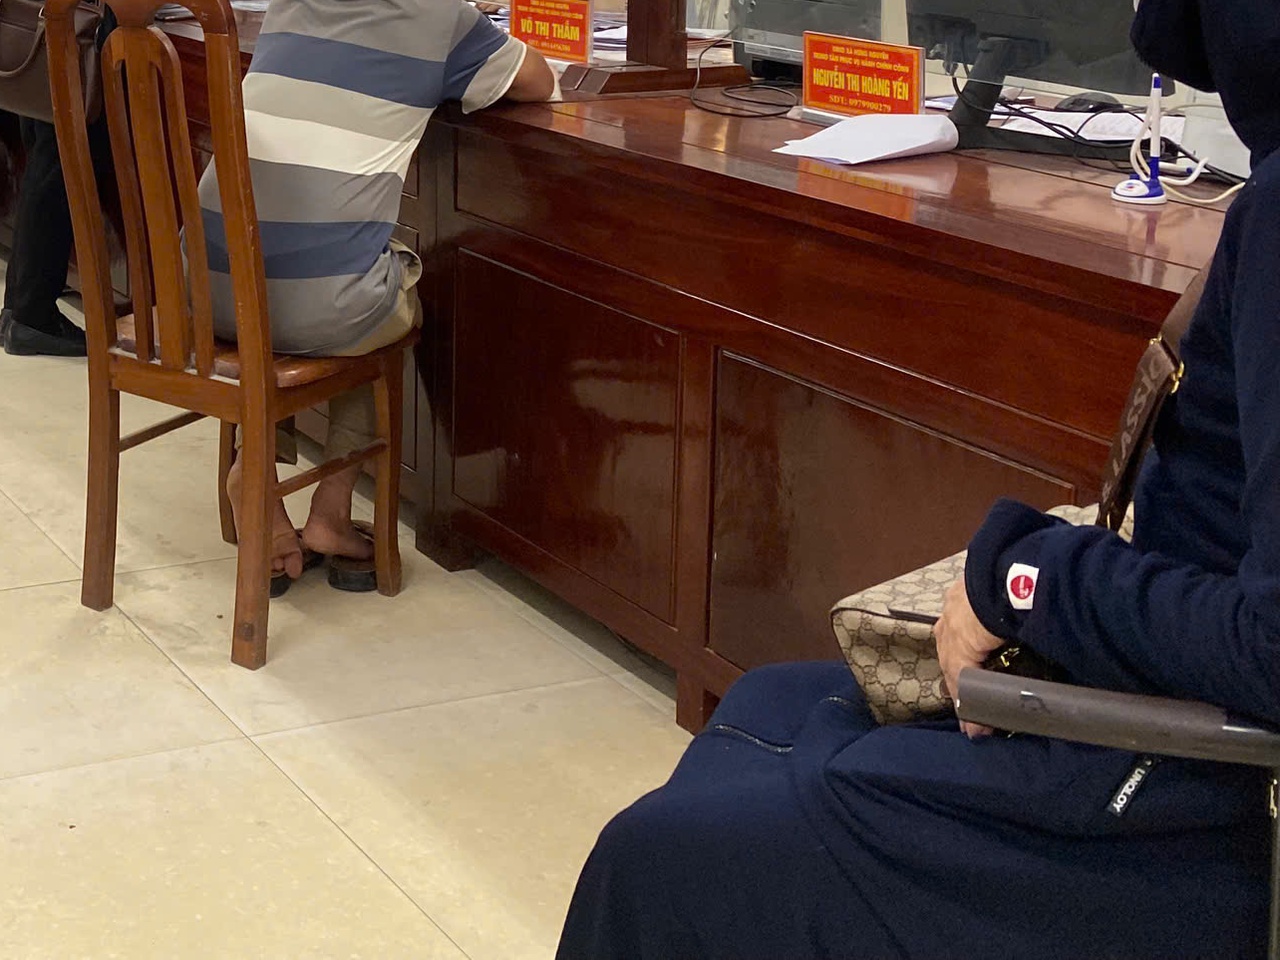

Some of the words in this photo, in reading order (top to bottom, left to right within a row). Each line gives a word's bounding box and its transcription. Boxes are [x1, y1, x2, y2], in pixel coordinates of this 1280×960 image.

[535, 20, 550, 40] THỊ
[813, 65, 845, 90] NGUYỄN
[846, 72, 860, 96] THỊ
[861, 74, 891, 98] HOÀNG
[892, 76, 909, 101] YẾN
